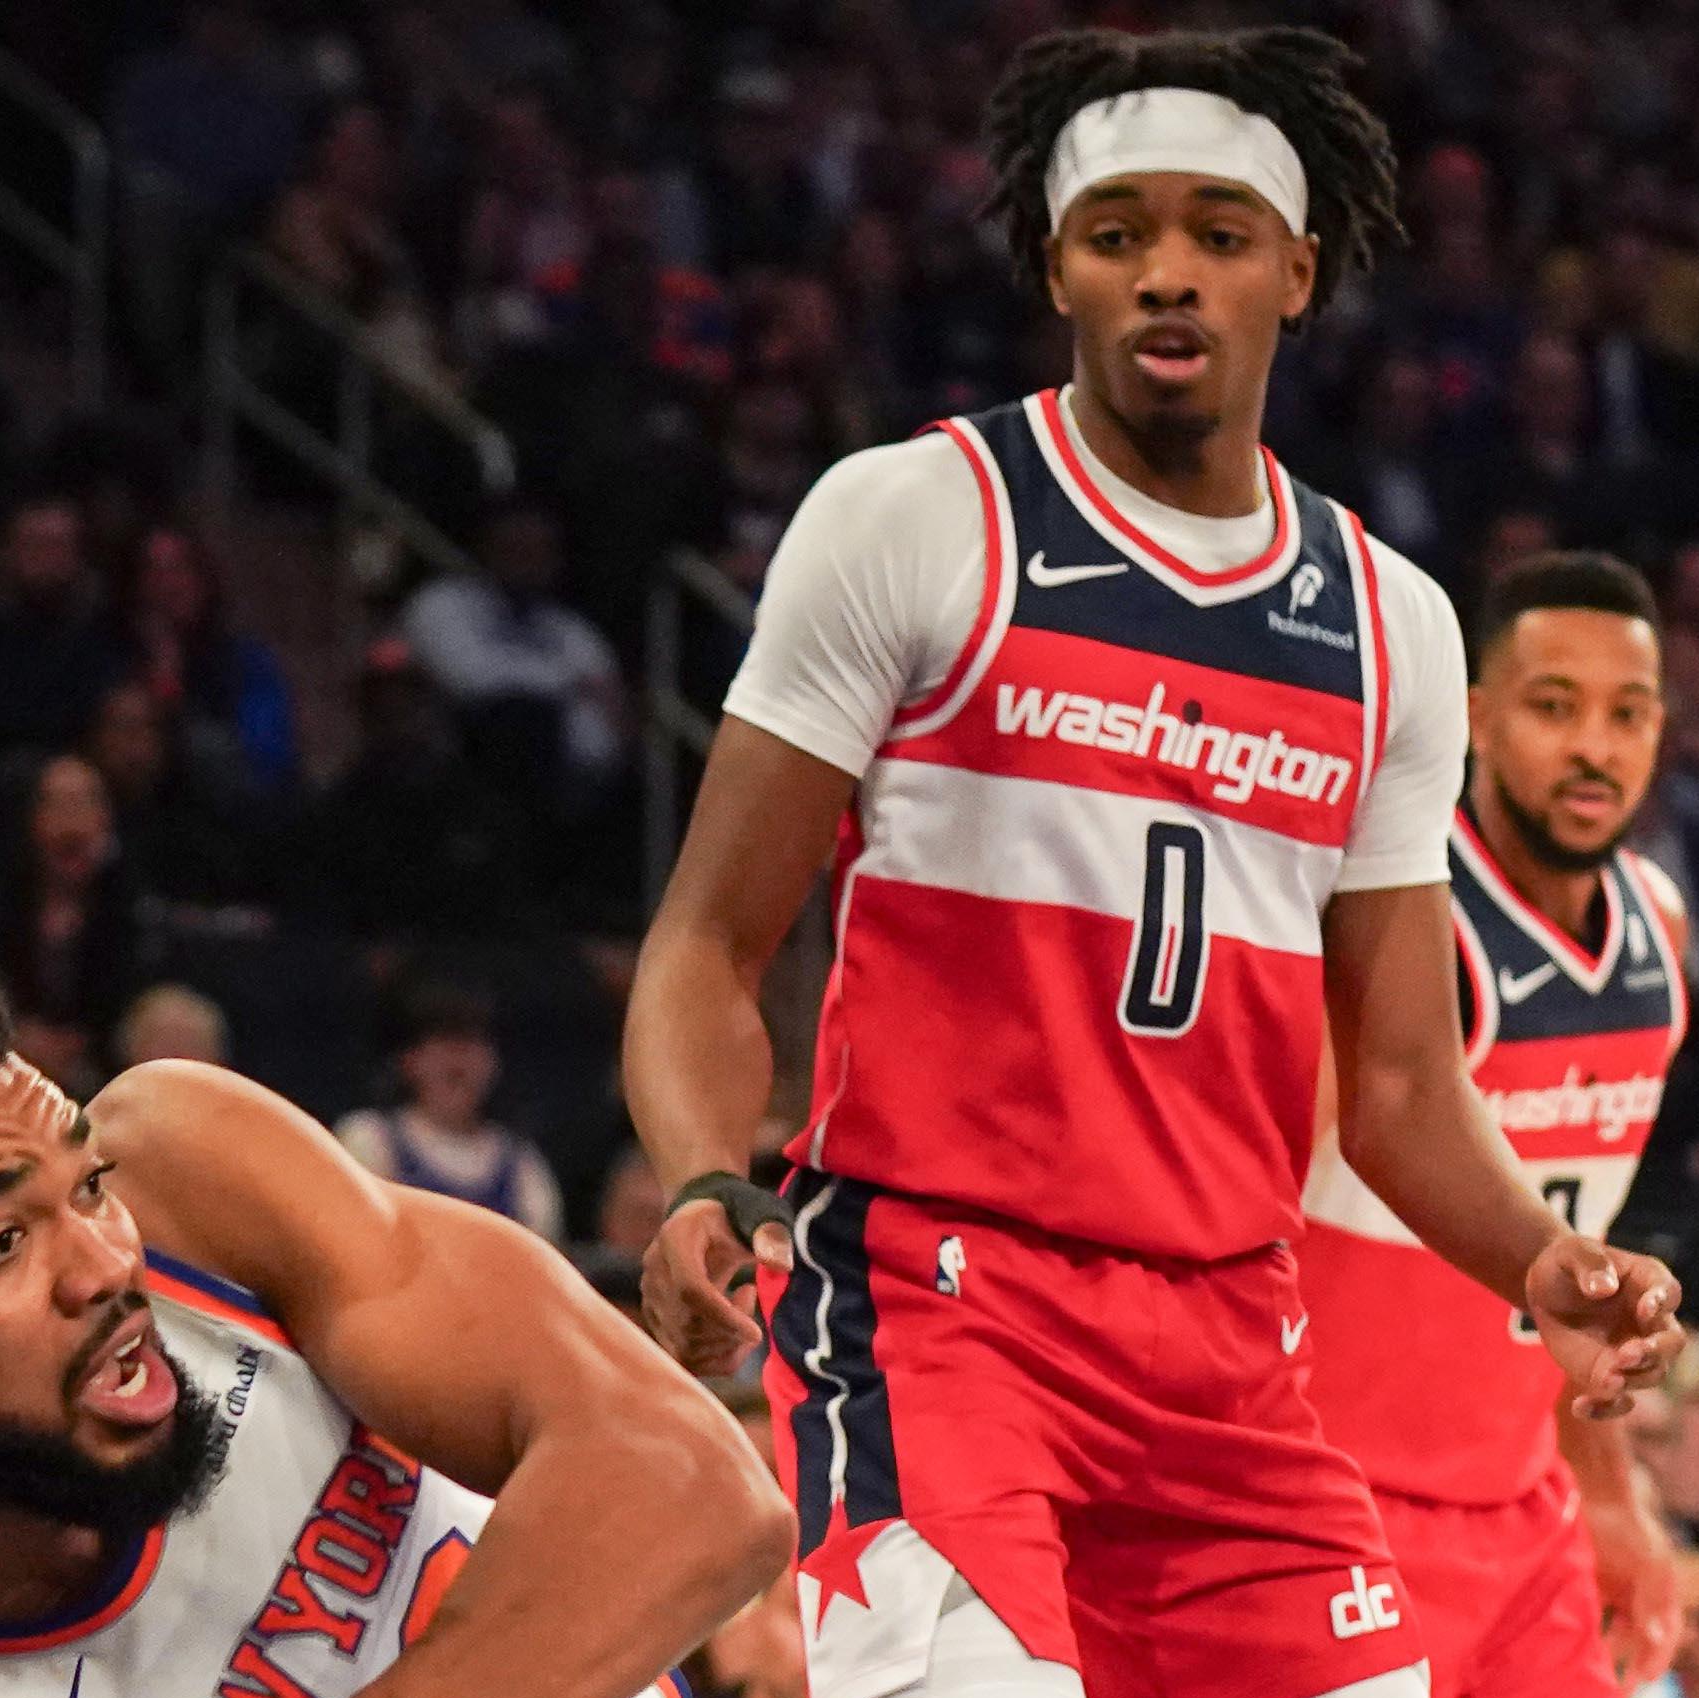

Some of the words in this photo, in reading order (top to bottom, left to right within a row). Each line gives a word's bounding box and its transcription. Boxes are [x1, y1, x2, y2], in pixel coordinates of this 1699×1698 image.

[995, 682, 1352, 805] washington
[1117, 819, 1212, 1039] 0
[1329, 1564, 1400, 1640] dc
